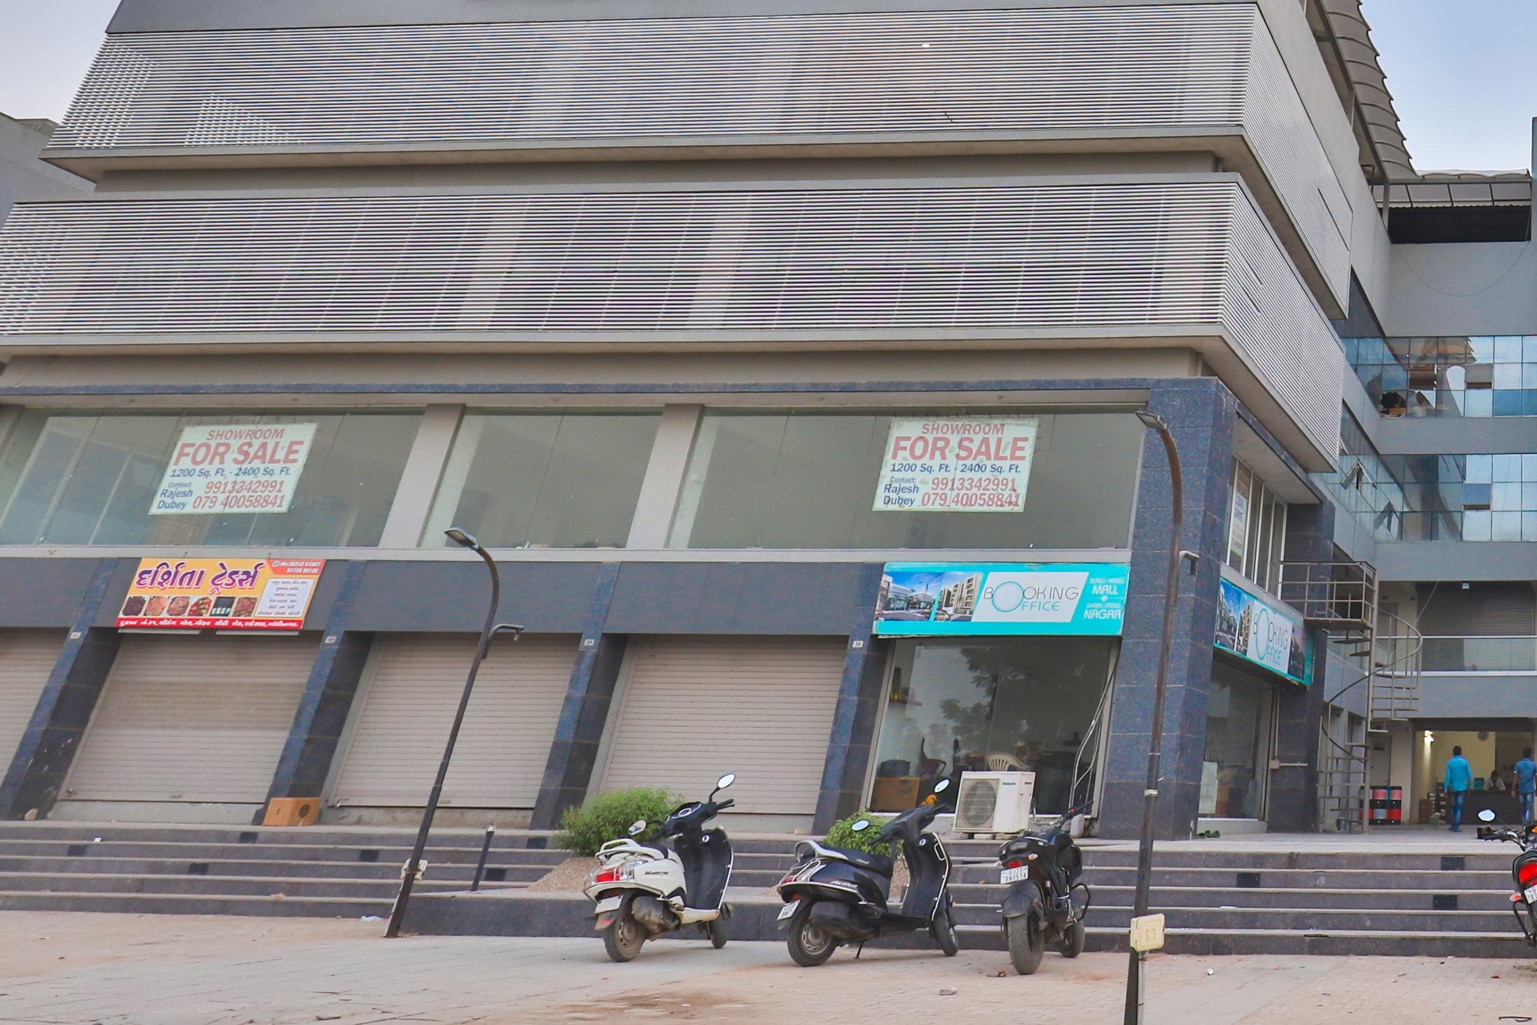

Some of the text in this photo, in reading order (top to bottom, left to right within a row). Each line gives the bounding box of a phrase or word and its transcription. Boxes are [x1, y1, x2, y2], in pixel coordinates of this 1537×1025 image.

[206, 428, 285, 441] SHOWROOM
[921, 423, 1005, 435] SHOWROOM
[173, 440, 304, 466] FOR SALE
[891, 436, 1029, 461] FOR SALE
[170, 468, 196, 477] 1200
[197, 468, 211, 478] Sq.
[214, 467, 226, 476] Ft.
[235, 467, 260, 476] 2400
[262, 467, 276, 477] Sq.
[279, 466, 291, 475] Ft.
[890, 463, 918, 473] 1200
[919, 463, 935, 474] Sq.
[938, 463, 950, 473] Ft.
[960, 463, 987, 473] 2400
[990, 464, 1005, 474] Sq.
[1008, 464, 1021, 473] Ft.
[204, 480, 285, 494] 9913342991
[883, 484, 919, 495] Rajesh
[931, 477, 1017, 492] 9913342991
[160, 488, 194, 499] Rajesh
[921, 492, 1021, 507] 079 40058841
[157, 500, 188, 510] Dubey
[192, 494, 285, 509] 079 40058841
[883, 495, 916, 507] Dubey
[1091, 584, 1119, 595] MALL
[983, 581, 1079, 613] BOOKING
[1083, 609, 1121, 620] NAGAR
